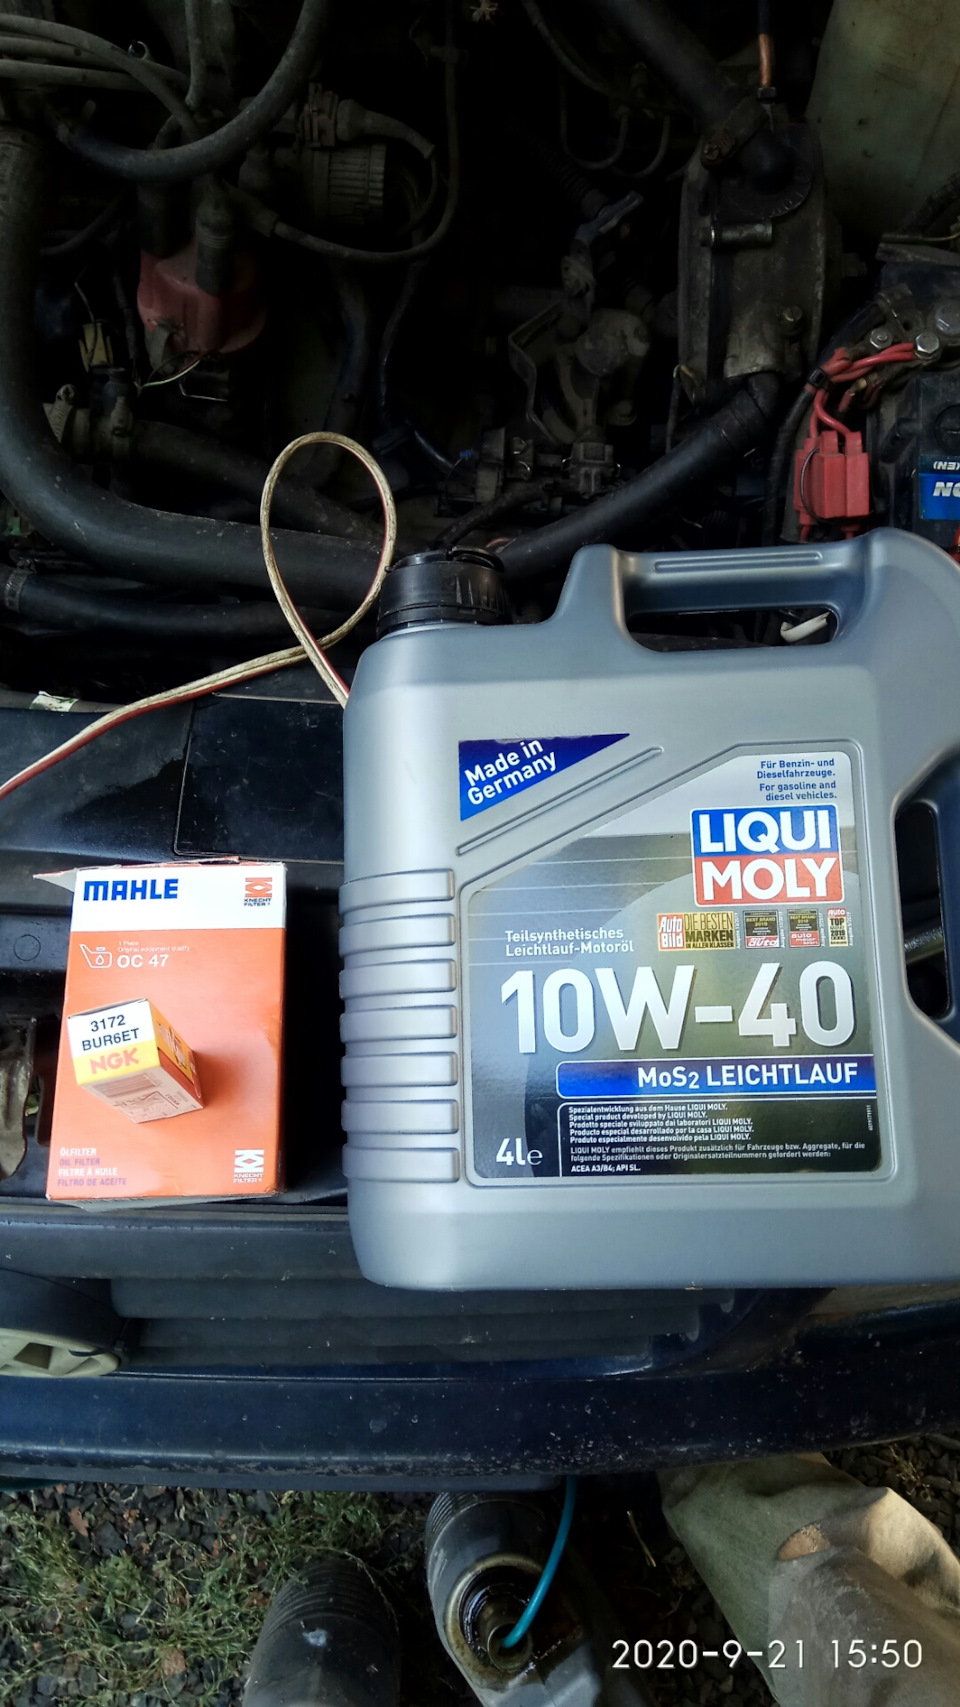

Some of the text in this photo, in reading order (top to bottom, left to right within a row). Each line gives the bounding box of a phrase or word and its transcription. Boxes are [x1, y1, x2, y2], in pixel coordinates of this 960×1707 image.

[464, 738, 543, 786] Made in
[760, 758, 835, 768] Für Benzin- und
[468, 751, 557, 806] Germany
[757, 769, 836, 778] Dieselfahrzeuge.
[760, 780, 836, 792] For gasoline and
[766, 791, 837, 800] diesel vehicles.
[699, 809, 831, 854] LIQUI
[701, 856, 837, 900] MOLY
[84, 878, 178, 902] MAHLE
[659, 916, 683, 932] Auto
[684, 912, 733, 930] DIE BESTEN
[830, 918, 844, 926] TOP
[505, 927, 625, 944] Teilsynthetisches
[662, 932, 684, 948] Bild
[686, 930, 734, 942] MARKEN
[505, 938, 634, 957] Leichtlauf-Motoröl
[117, 954, 169, 968] OC 47
[500, 960, 855, 1054] 10W-40
[90, 1014, 126, 1032] 3172
[82, 1028, 140, 1051] BUR6ET
[90, 1047, 140, 1074] NGK
[706, 1062, 858, 1086] LEICHTLAUF
[600, 1120, 628, 1128] speciale
[629, 1120, 664, 1128] sviluppato
[601, 1128, 630, 1136] especial
[598, 1136, 648, 1144] especialmente
[60, 1148, 96, 1156] ÖLFILTER
[611, 1146, 644, 1154] empfiehlt
[747, 1144, 784, 1152] Fahrzeuge
[802, 1142, 840, 1151] Aggregate,
[570, 1154, 600, 1162] folgende
[602, 1154, 654, 1162] Spezifikationen
[768, 1151, 800, 1159] gefordert
[58, 1168, 84, 1176] FILTRE
[95, 1168, 118, 1176] HUILE
[100, 1178, 127, 1186] ACEITE
